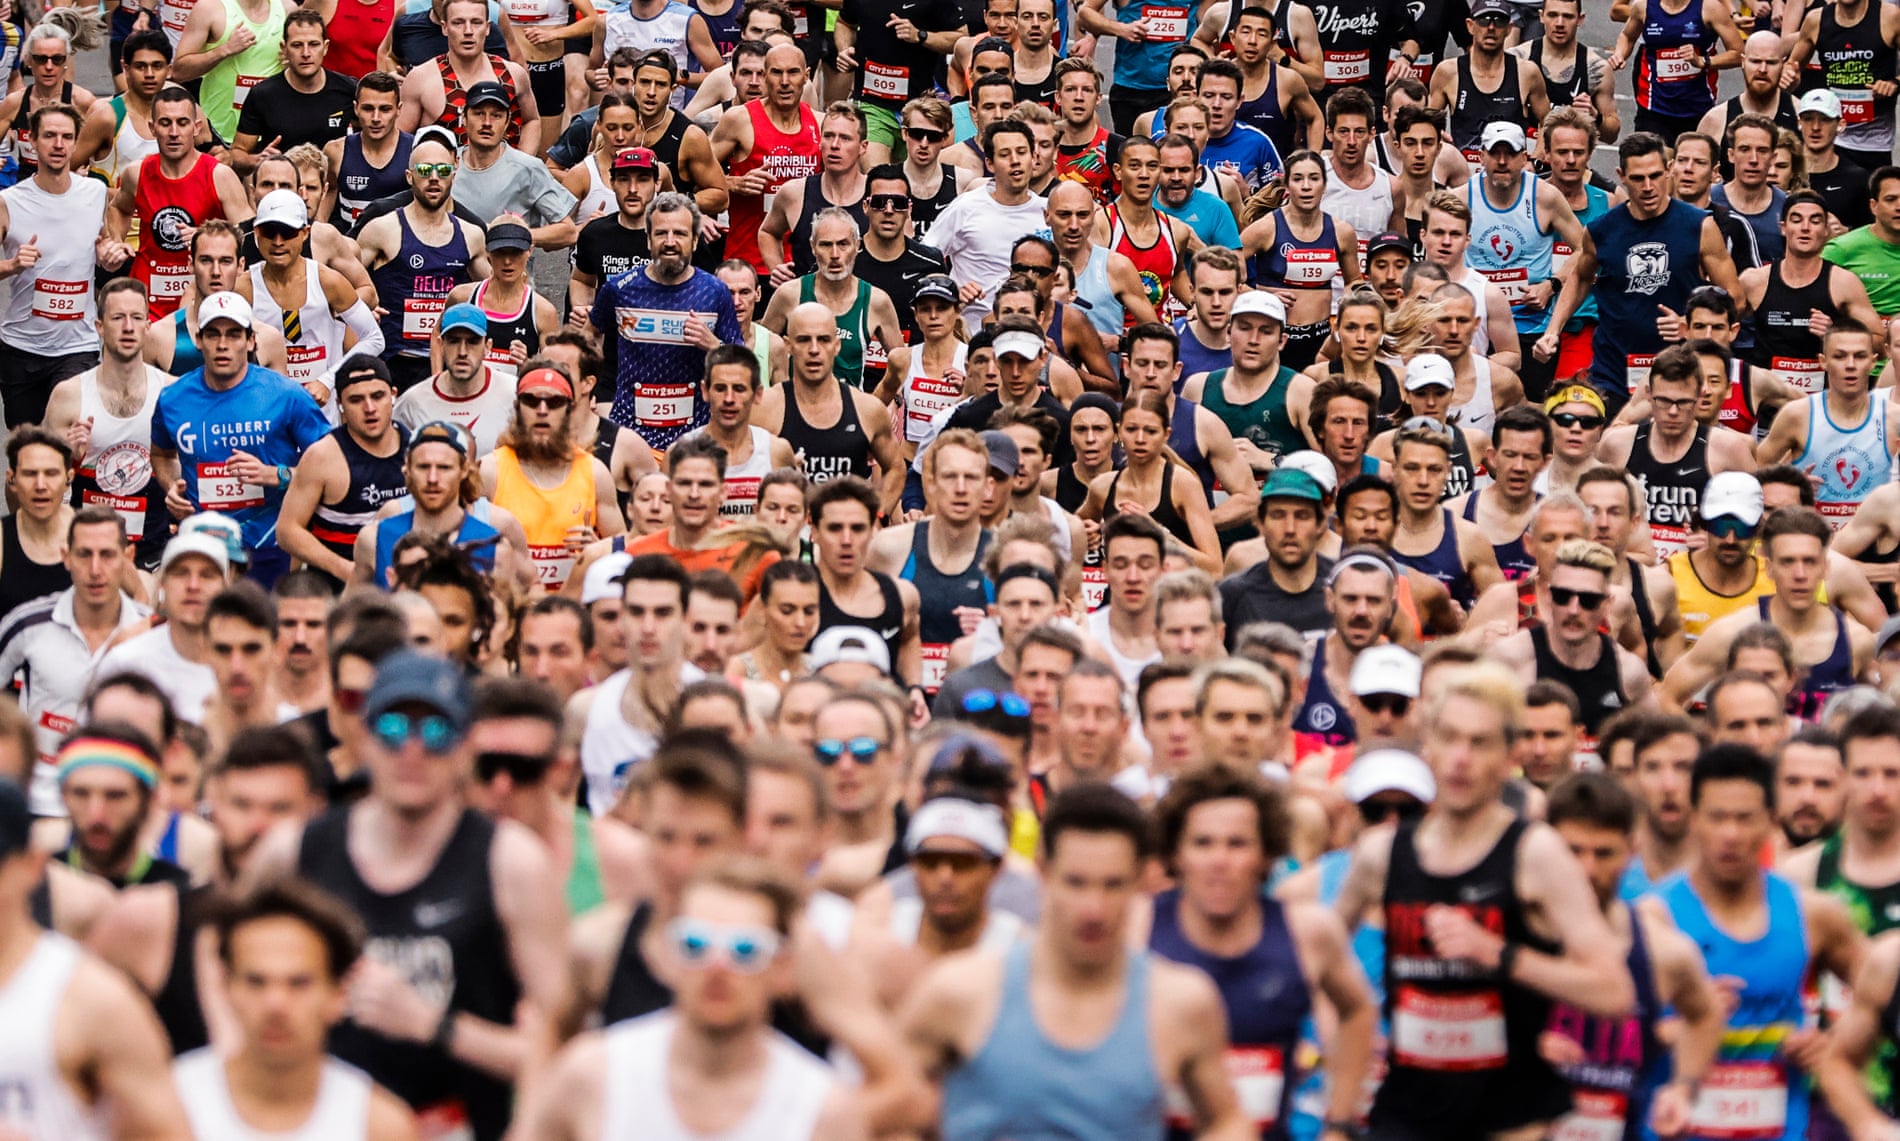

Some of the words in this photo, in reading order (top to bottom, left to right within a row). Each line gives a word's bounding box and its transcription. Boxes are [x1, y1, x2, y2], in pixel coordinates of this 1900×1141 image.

[511, 2, 538, 10] BURKE
[1153, 22, 1175, 33] 226
[1315, 5, 1379, 43] Vipers
[1824, 49, 1874, 61] SUUNTO
[1336, 66, 1359, 76] 308
[1667, 62, 1690, 73] 390
[873, 79, 896, 91] 609
[328, 117, 341, 127] EY
[763, 155, 818, 167] KIRRIBILLI
[768, 166, 815, 178] UNNERS
[602, 255, 629, 268] Kings
[602, 264, 629, 273] Track
[1302, 267, 1322, 278] 139
[49, 298, 74, 310] 582
[641, 387, 688, 397] CITY2SURF
[652, 403, 676, 415] 251
[211, 420, 271, 436] GILBERT
[810, 456, 852, 472] run
[215, 484, 244, 497] 523
[395, 486, 408, 497] FIT
[1650, 486, 1698, 504] run
